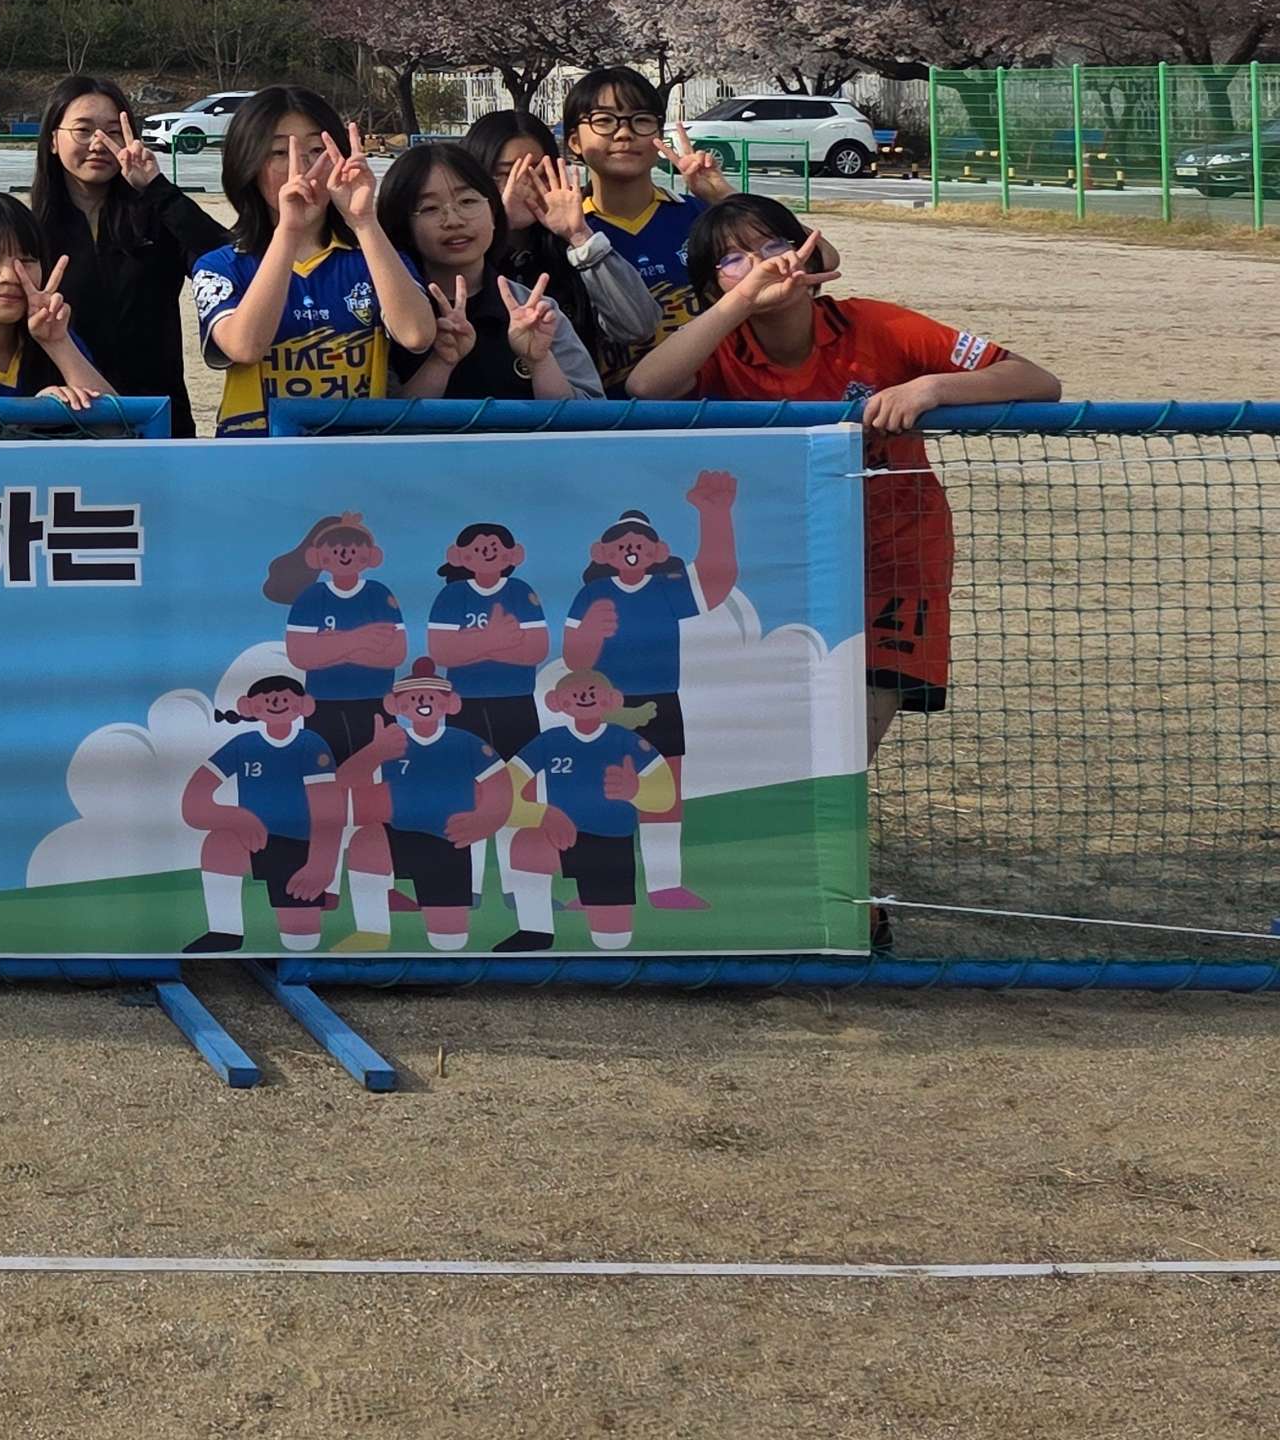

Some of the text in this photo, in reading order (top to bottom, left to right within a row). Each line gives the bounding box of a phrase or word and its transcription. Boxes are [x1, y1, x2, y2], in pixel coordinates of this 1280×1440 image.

[324, 615, 337, 631] 9
[465, 612, 489, 630] 26
[243, 761, 263, 777] 13
[398, 759, 410, 775] 7
[551, 758, 574, 774] 22
